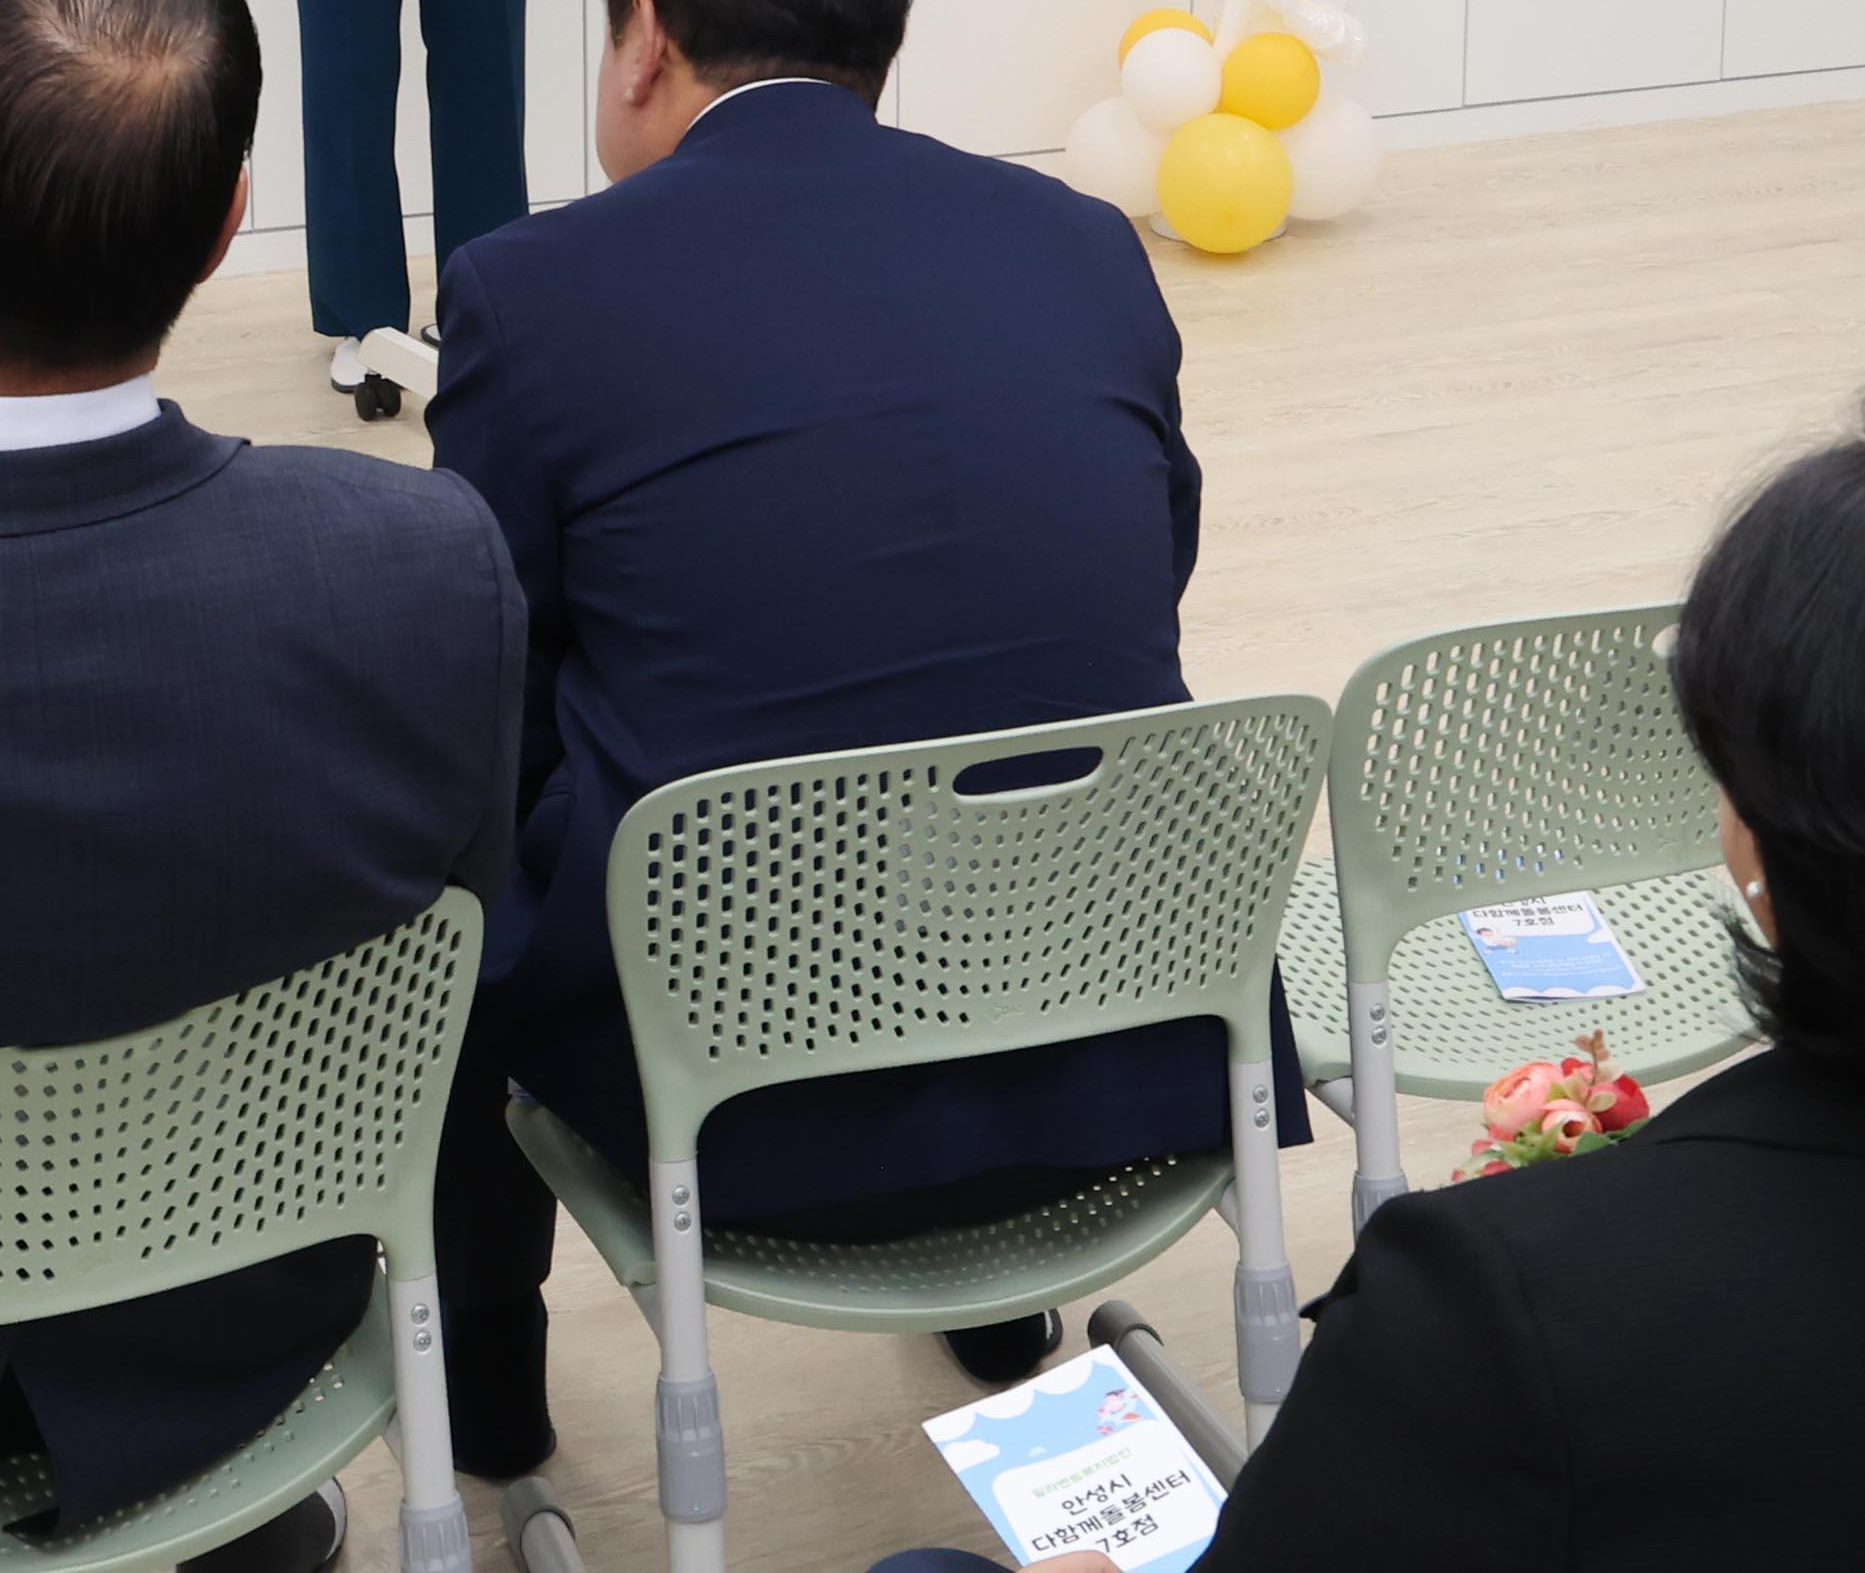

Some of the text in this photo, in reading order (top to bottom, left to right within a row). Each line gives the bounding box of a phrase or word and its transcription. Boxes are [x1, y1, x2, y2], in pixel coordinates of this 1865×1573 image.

[1472, 904, 1584, 919] 다함께돌봄센터
[1512, 917, 1555, 927] 7호점
[1032, 1470, 1192, 1552] 다함께돌봄센터
[1062, 1473, 1133, 1516] 안성시
[1095, 1514, 1160, 1554] 7호점
